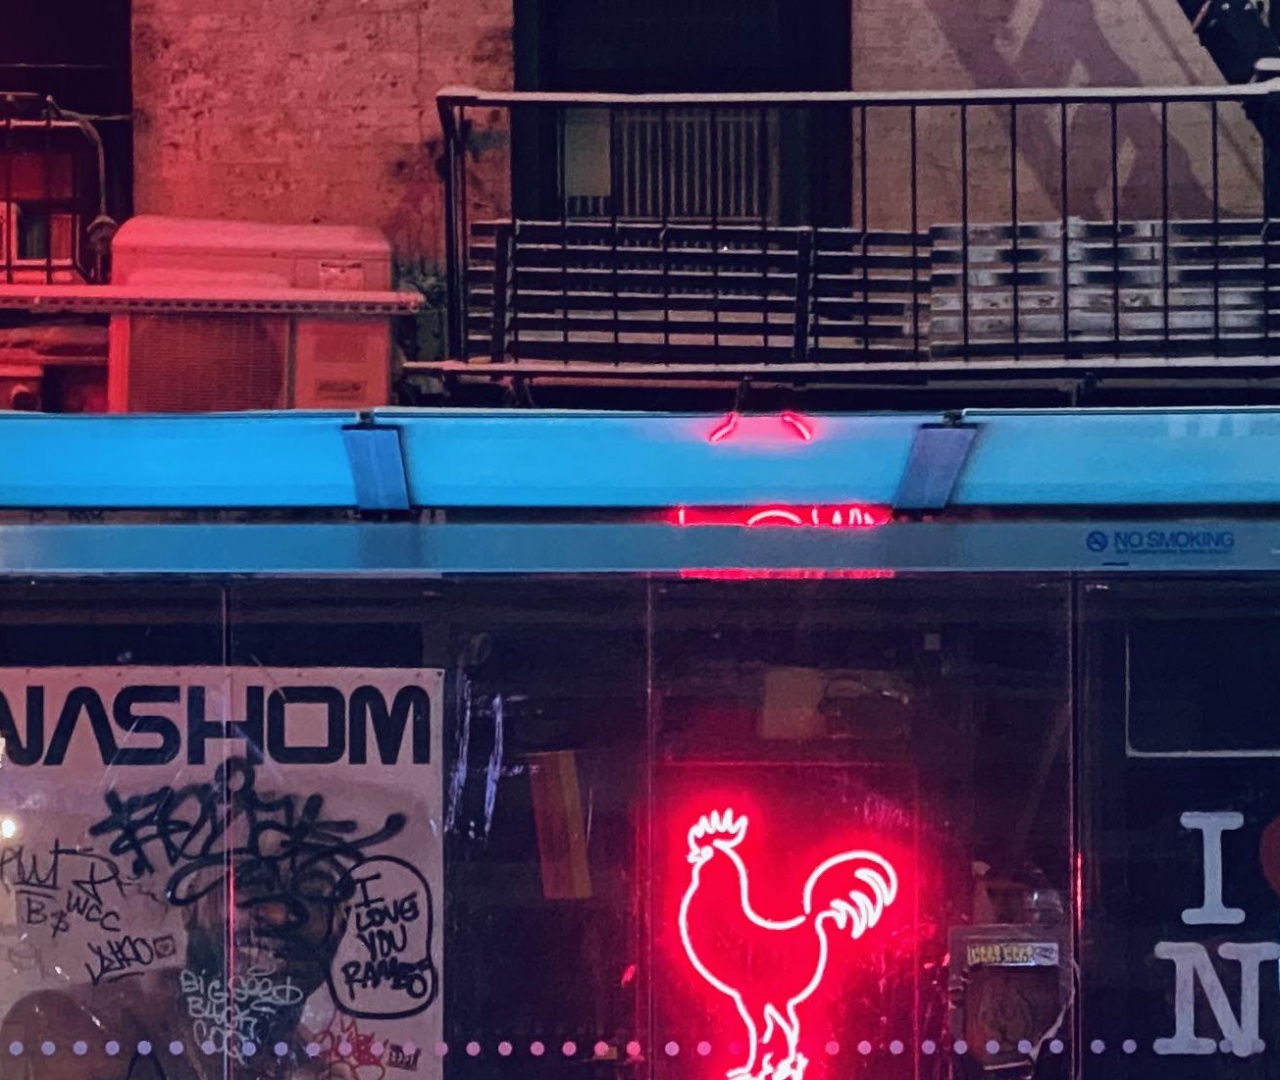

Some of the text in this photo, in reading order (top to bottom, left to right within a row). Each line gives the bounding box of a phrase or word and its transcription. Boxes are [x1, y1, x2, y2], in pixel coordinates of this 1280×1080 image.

[1113, 531, 1235, 548] NO SMOKING
[1180, 811, 1246, 925] I
[356, 892, 419, 932] LOVE
[357, 924, 407, 962] YOU
